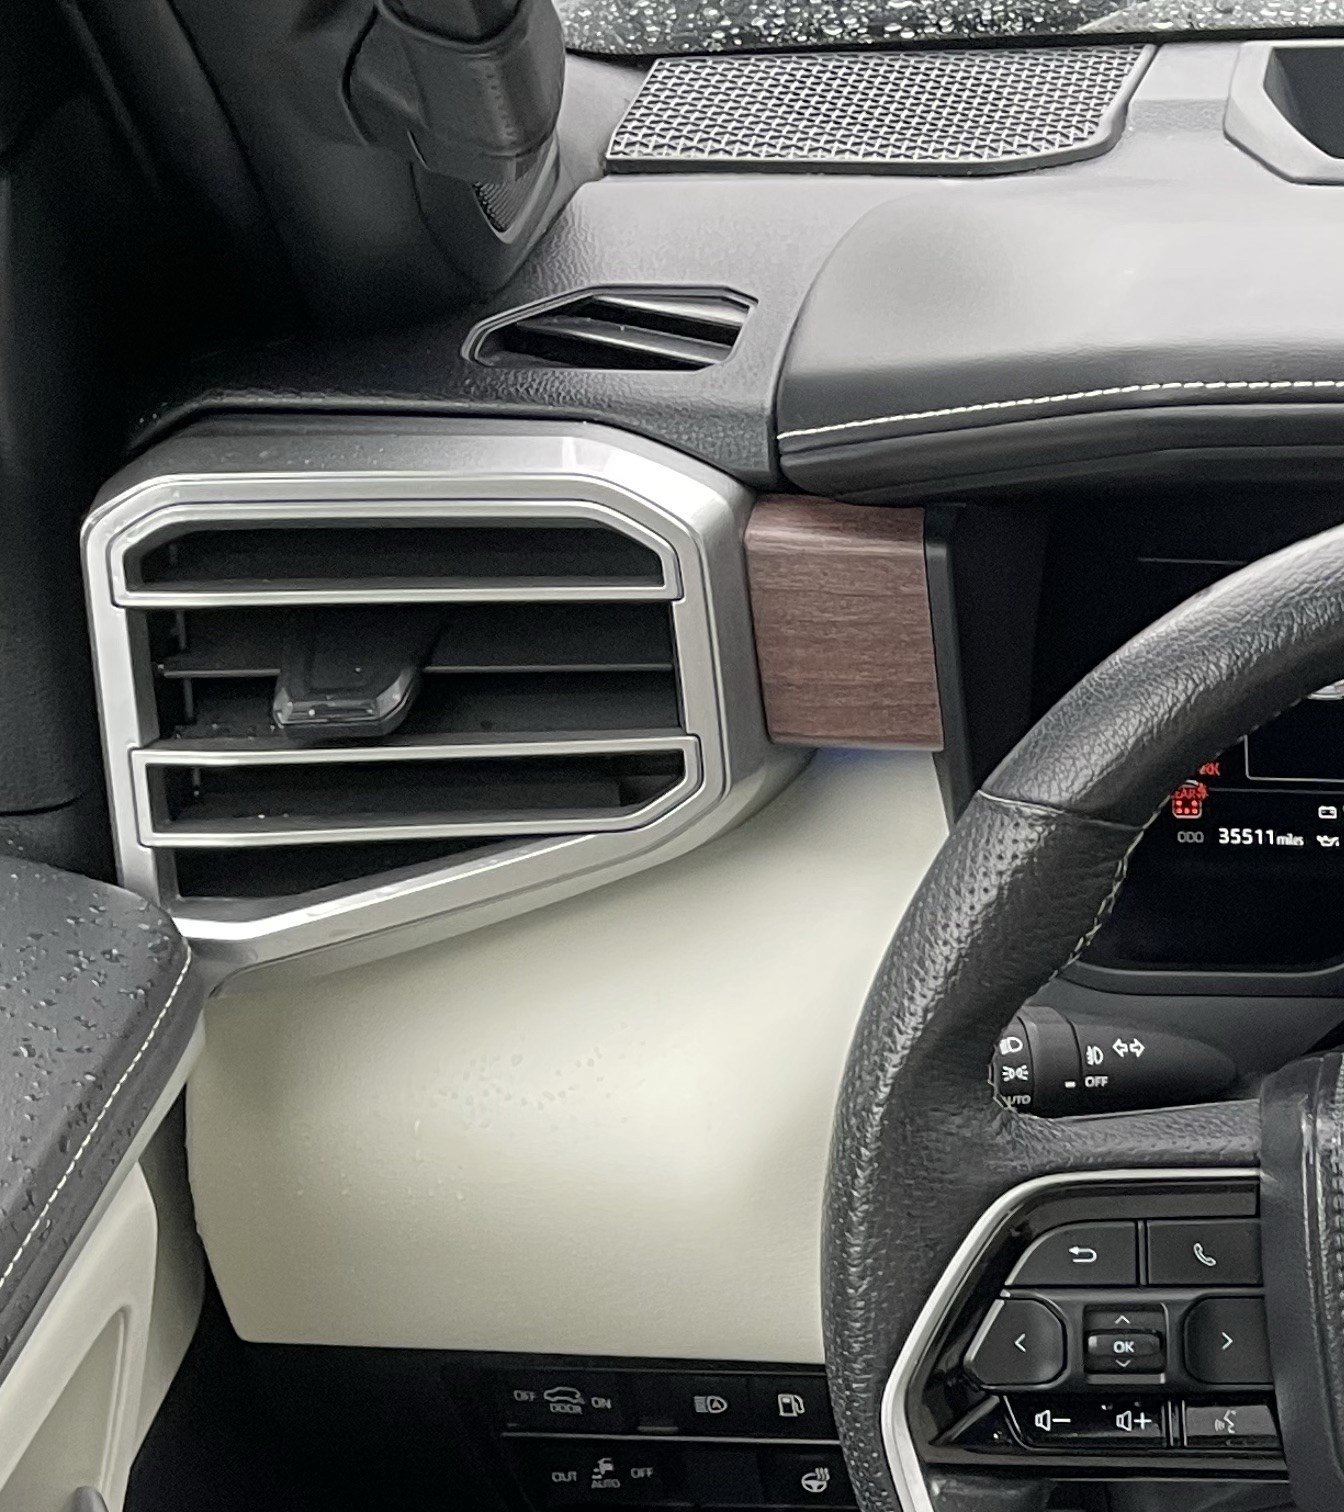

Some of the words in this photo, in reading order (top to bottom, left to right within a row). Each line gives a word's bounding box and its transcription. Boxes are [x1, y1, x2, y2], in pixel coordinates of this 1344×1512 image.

[1218, 828, 1275, 845] 35511
[1085, 1076, 1109, 1088] OFF
[1113, 1341, 1135, 1354] OK
[590, 1397, 612, 1410] ON
[551, 1471, 578, 1483] OUT
